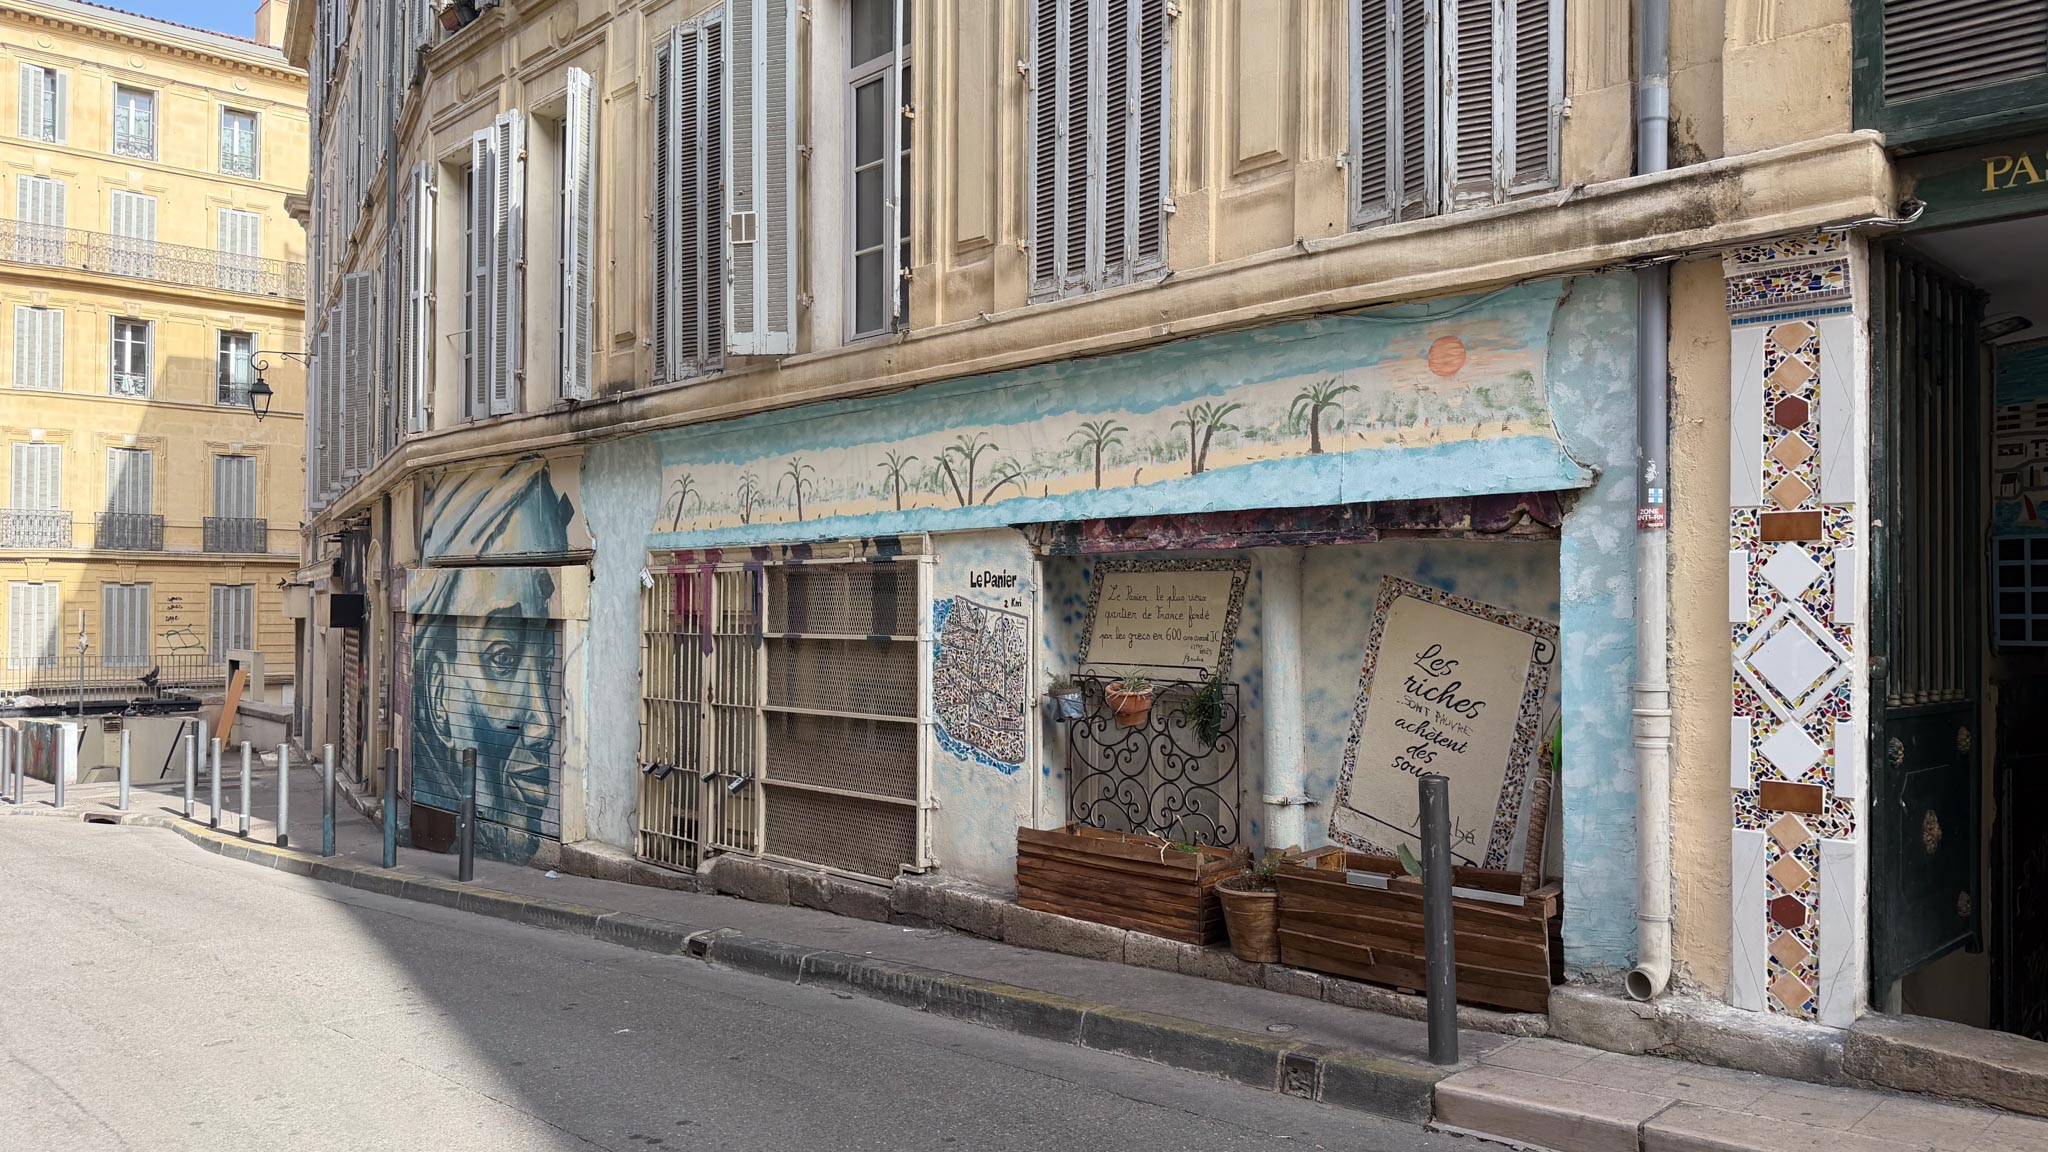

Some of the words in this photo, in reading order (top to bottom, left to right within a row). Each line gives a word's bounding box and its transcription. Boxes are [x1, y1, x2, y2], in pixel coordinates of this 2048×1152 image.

[1981, 150, 2048, 192] PA
[970, 570, 983, 588] Le
[983, 568, 1017, 588] Panier
[1003, 599, 1009, 608] 2
[1107, 584, 1120, 601] Le
[1156, 585, 1164, 601] le
[1166, 584, 1186, 608] plus
[1188, 594, 1208, 602] vieux
[1104, 607, 1138, 626] quartier
[1142, 607, 1153, 620] de
[1155, 605, 1185, 620] France
[1188, 605, 1210, 628] fondé
[1098, 633, 1114, 649] par
[1115, 626, 1127, 640] les
[1128, 631, 1151, 649] grecs
[1152, 632, 1165, 641] en
[1165, 627, 1182, 641] 600
[1413, 643, 1459, 678] Les
[1403, 675, 1487, 719] riches
[1394, 718, 1468, 754] achètent
[1406, 742, 1438, 764] des
[1390, 756, 1450, 781] sou
